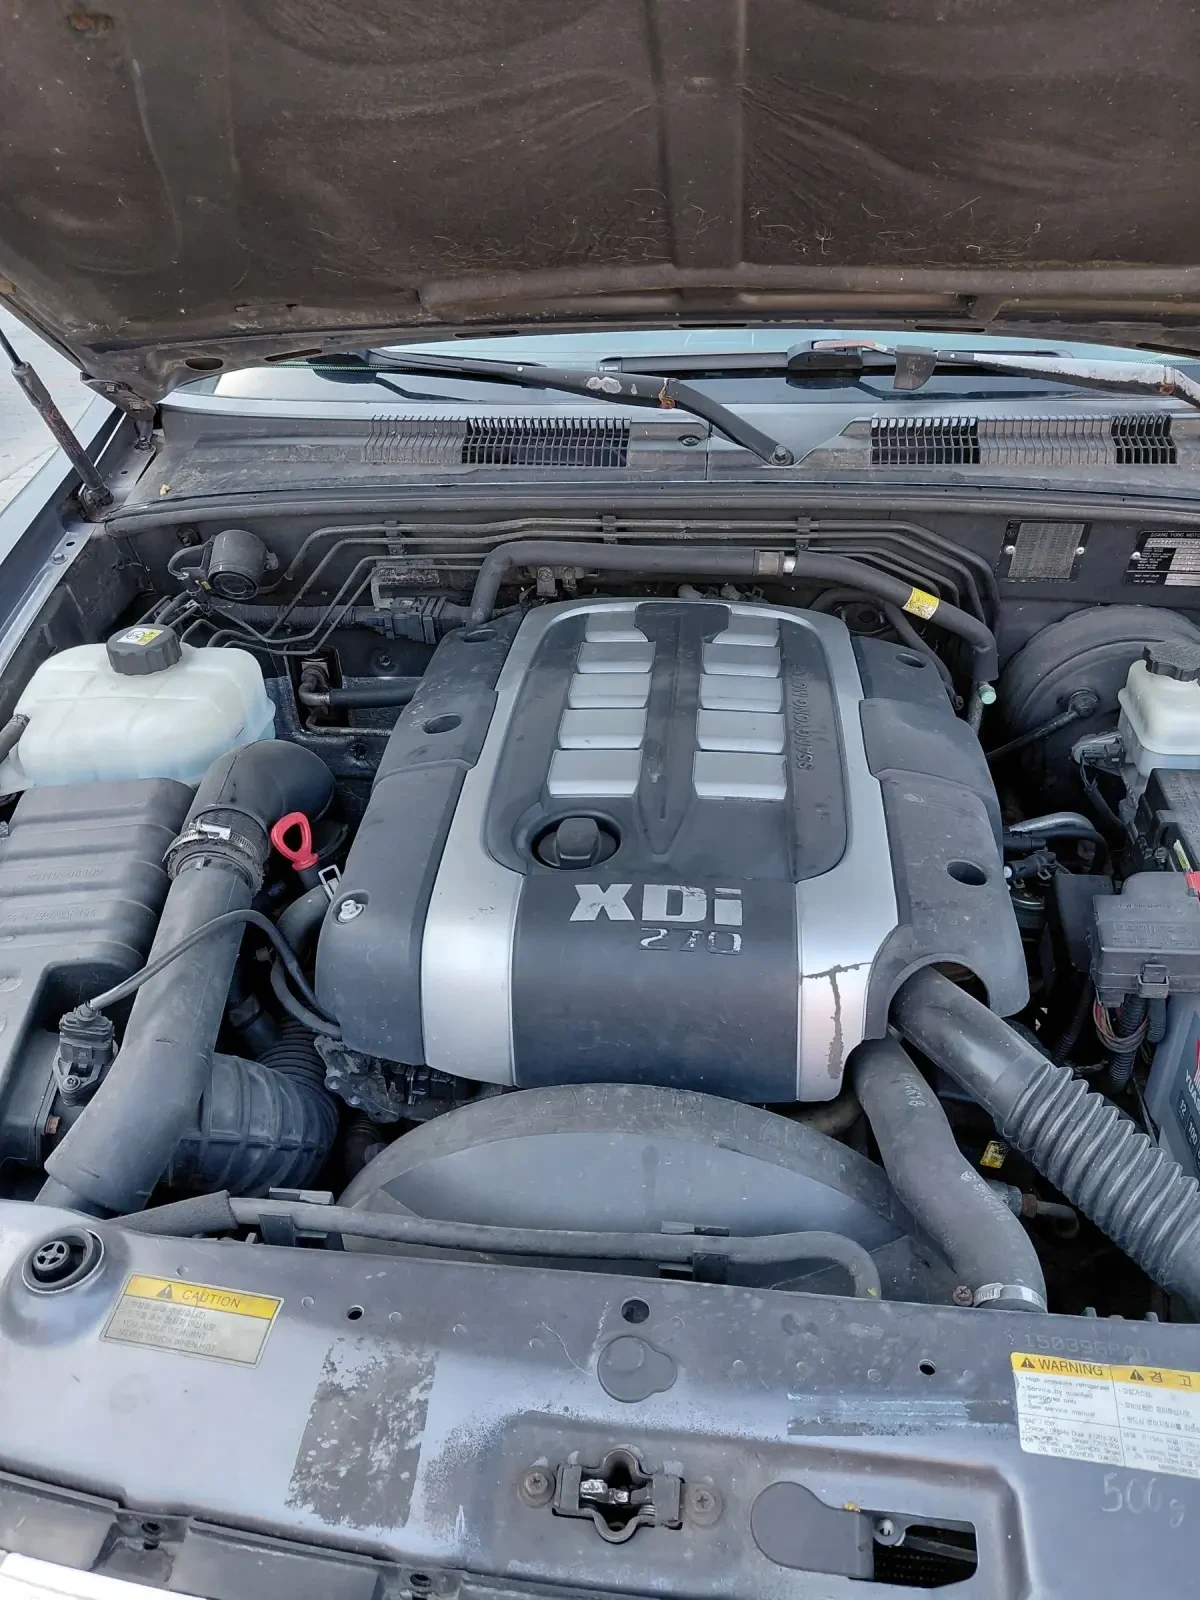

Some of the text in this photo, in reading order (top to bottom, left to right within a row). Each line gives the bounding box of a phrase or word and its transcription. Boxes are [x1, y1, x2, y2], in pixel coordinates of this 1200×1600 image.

[568, 883, 743, 926] XDi
[639, 927, 743, 956] 270
[1179, 1099, 1187, 1117] 12
[1188, 1121, 1198, 1145] 100
[181, 1289, 241, 1309] CAUTION
[1037, 1357, 1104, 1377] WARNING
[1026, 1385, 1052, 1394] Service
[1044, 1405, 1069, 1414] service
